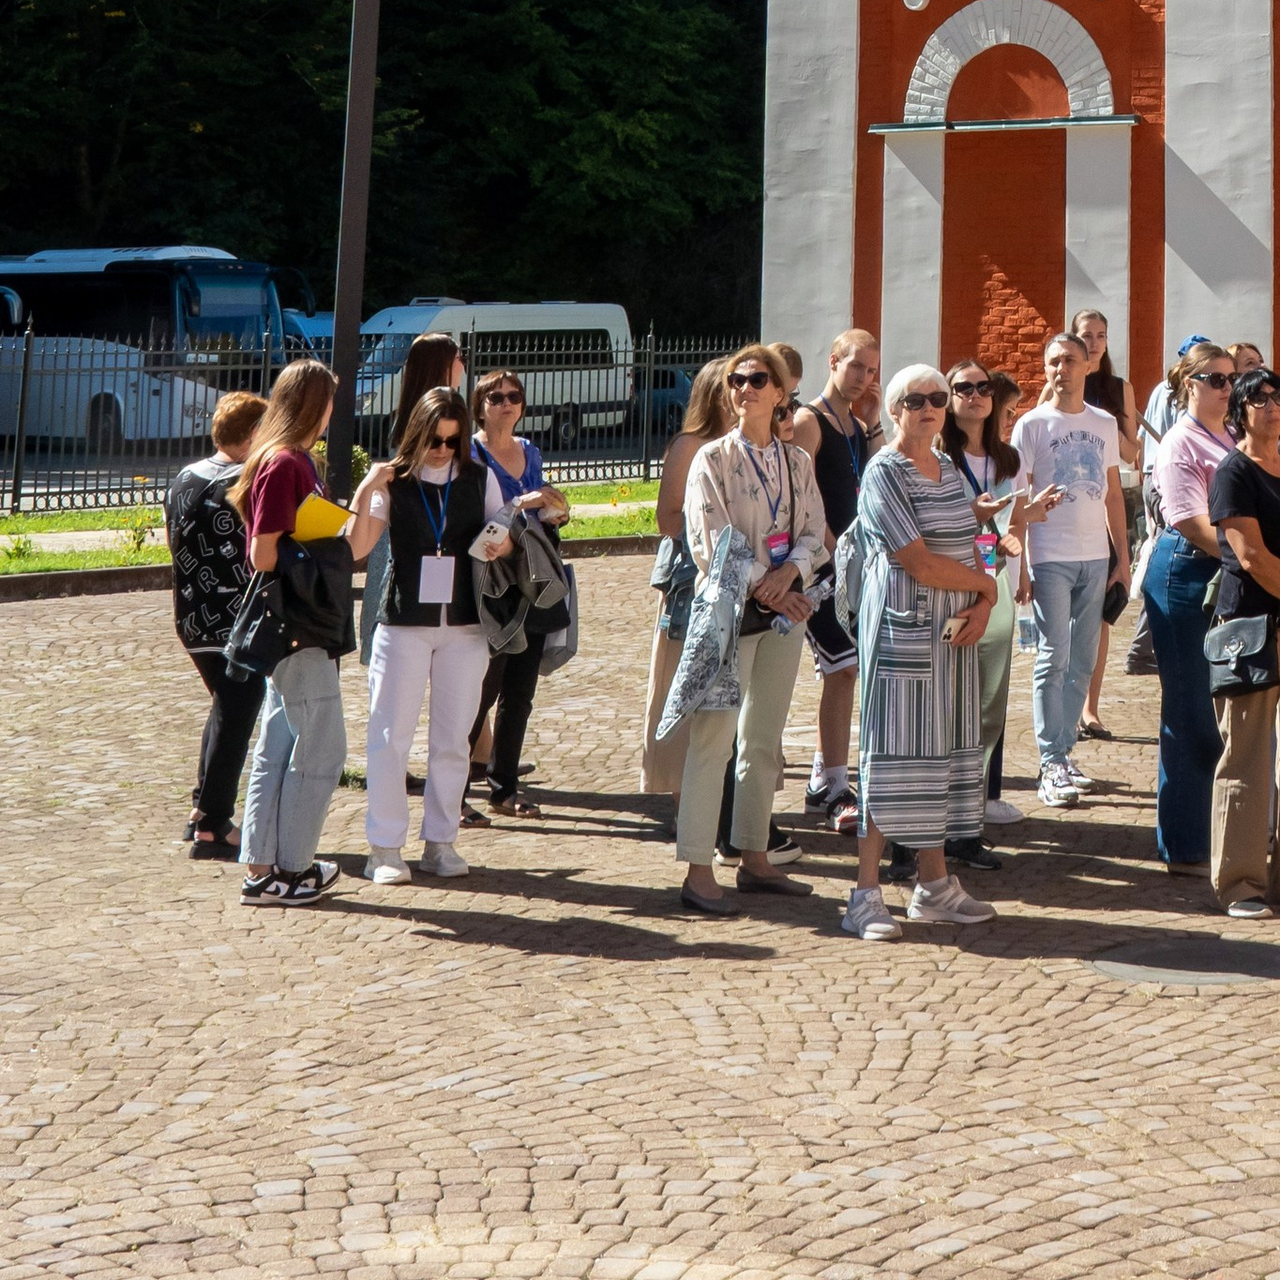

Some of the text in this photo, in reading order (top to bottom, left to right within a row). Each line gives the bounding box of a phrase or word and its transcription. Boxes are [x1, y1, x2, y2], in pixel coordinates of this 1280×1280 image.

[213, 510, 235, 535] G
[198, 533, 214, 557] L
[175, 546, 199, 575] E
[198, 566, 220, 593] R
[183, 611, 201, 642] K
[201, 603, 221, 627] L
